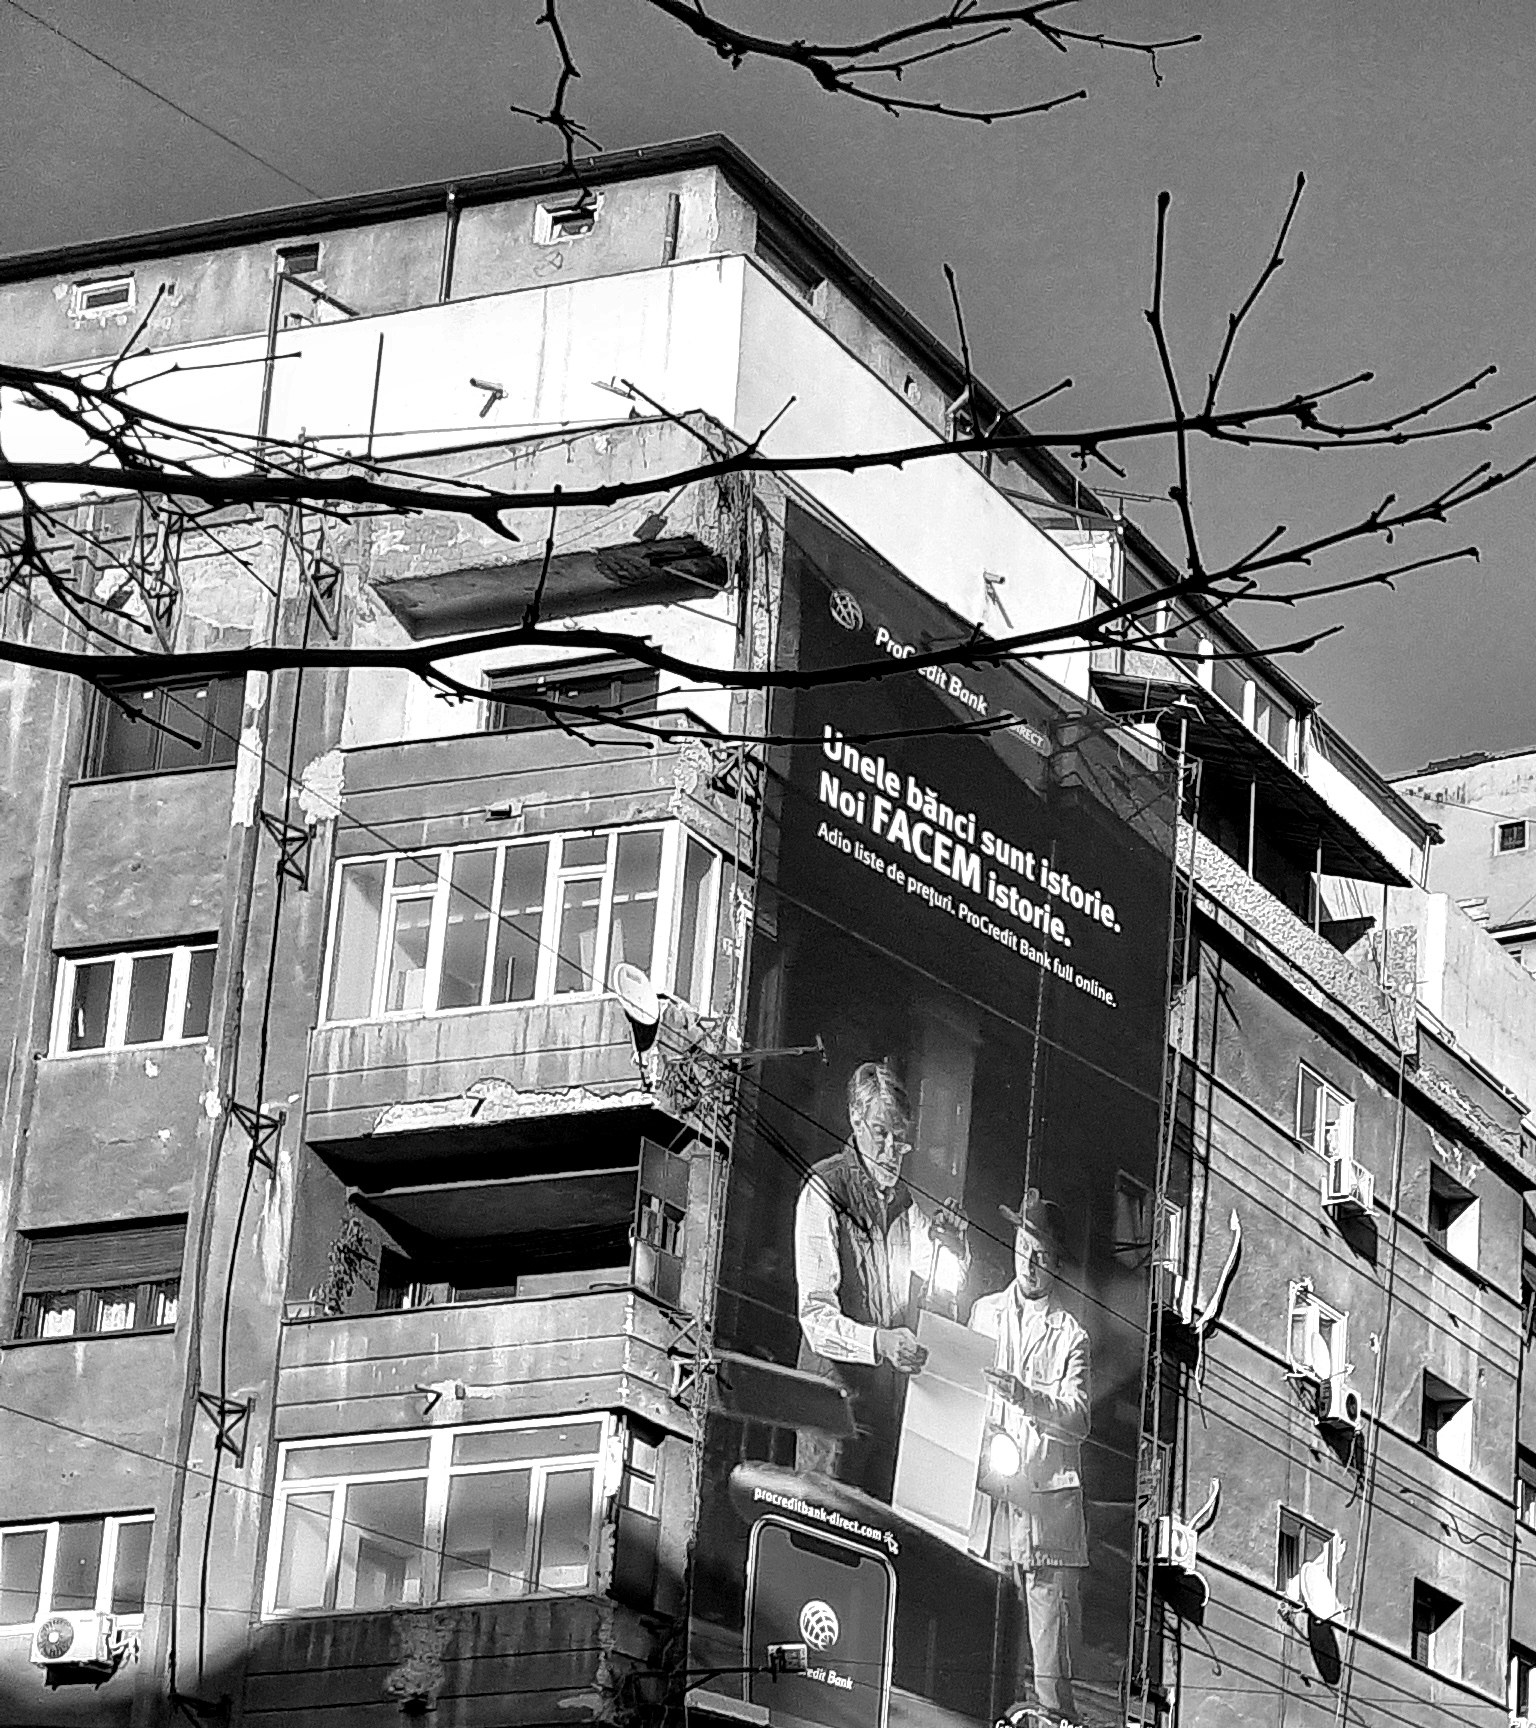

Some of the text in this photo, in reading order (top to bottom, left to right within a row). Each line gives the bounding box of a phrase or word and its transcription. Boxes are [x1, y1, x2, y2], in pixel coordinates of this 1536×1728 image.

[948, 674, 989, 717] Bank
[819, 770, 1073, 948] Noi FACEM istorie.
[822, 724, 1122, 933] Unele bănci sunt istorie.
[816, 821, 852, 854] Adio
[854, 840, 886, 874] liste
[886, 862, 906, 886] de
[958, 901, 1018, 952] ProCredit
[1019, 937, 1052, 971] Bank
[1053, 957, 1074, 984] full
[1074, 973, 1118, 1009] online.
[753, 1486, 883, 1541] procreditbank-direct.com
[827, 1669, 854, 1692] Bank
